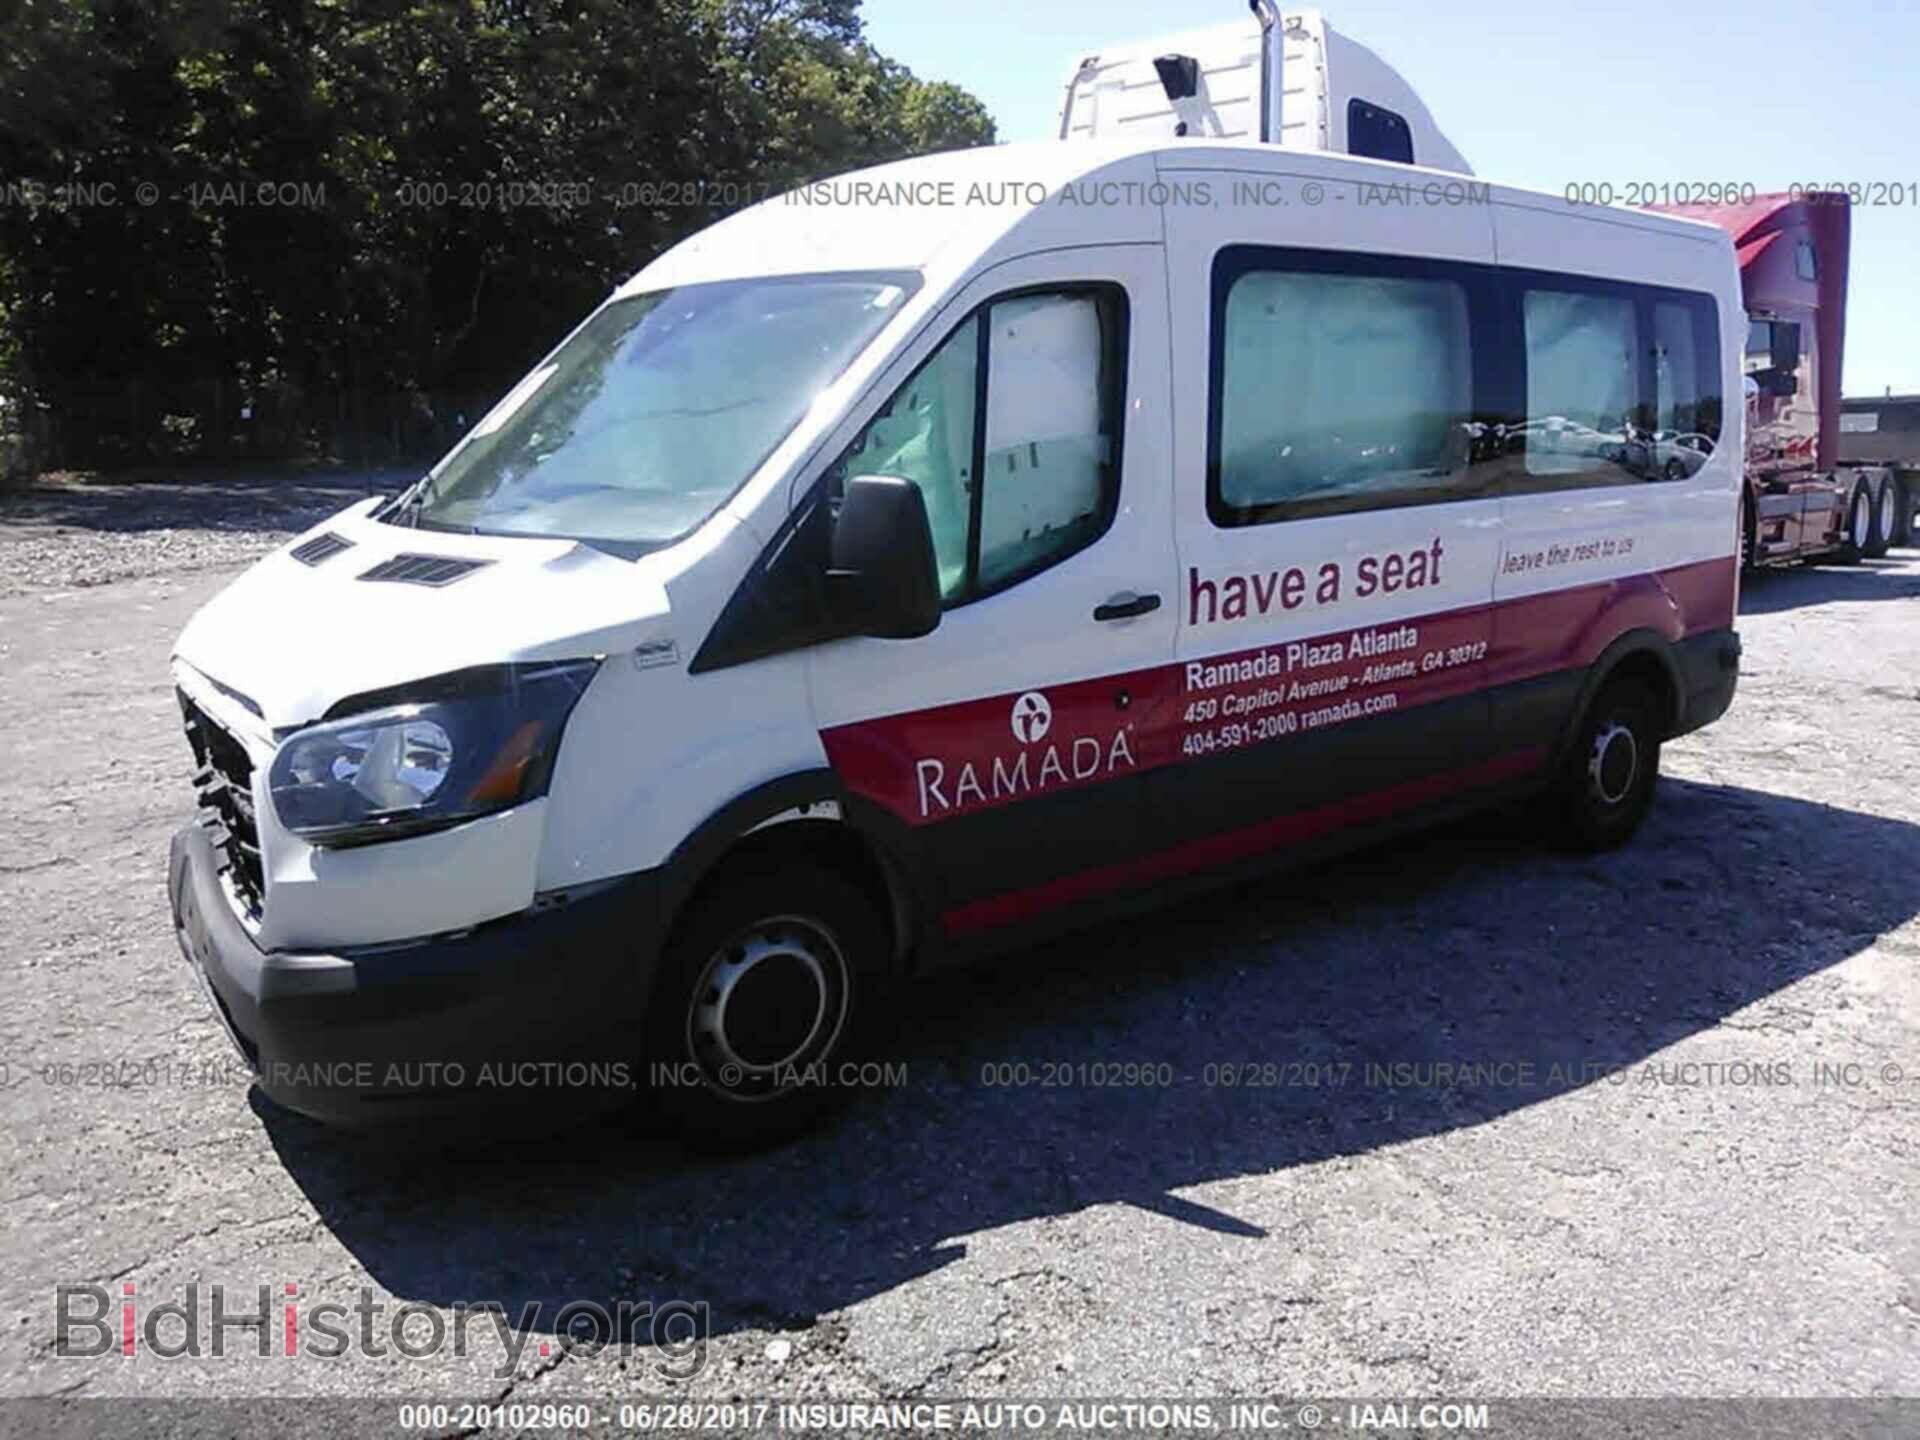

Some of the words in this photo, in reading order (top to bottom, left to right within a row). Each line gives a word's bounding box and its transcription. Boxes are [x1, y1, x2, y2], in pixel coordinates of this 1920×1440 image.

[1189, 567, 1305, 625] have
[1316, 563, 1340, 604] a
[1355, 536, 1443, 597] seat
[1502, 551, 1544, 575] leave
[1546, 544, 1570, 566] the
[1572, 541, 1600, 561] rest
[1601, 539, 1617, 557] to
[1618, 538, 1633, 555] us
[1183, 699, 1217, 723] 450
[1222, 684, 1286, 715] Capitol
[1286, 675, 1349, 701] Avenue
[1360, 660, 1417, 686] Atlanta,
[1421, 652, 1444, 671] GA
[1186, 651, 1280, 691] Ramada
[1286, 642, 1343, 671] Plaza
[1347, 625, 1418, 660] Atlanta
[1182, 711, 1297, 756] 404-591-2000
[1301, 693, 1398, 729] ramada.com
[915, 729, 1135, 816] RAMADA
